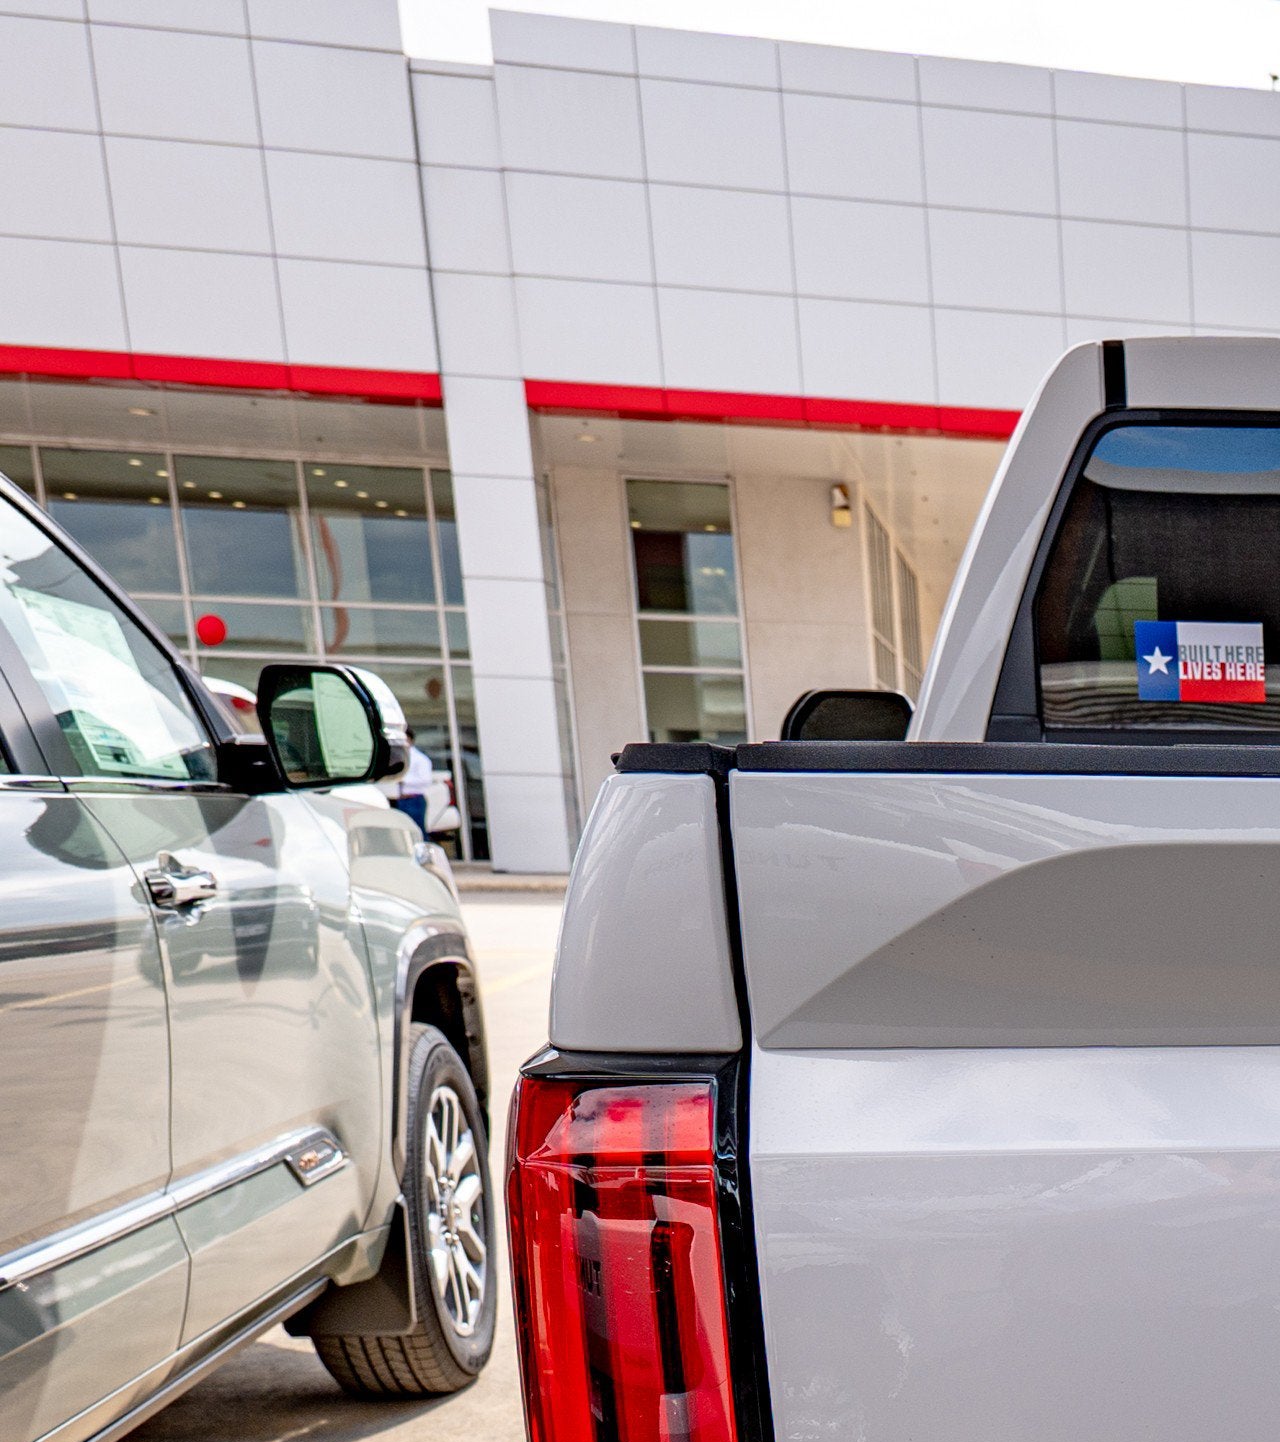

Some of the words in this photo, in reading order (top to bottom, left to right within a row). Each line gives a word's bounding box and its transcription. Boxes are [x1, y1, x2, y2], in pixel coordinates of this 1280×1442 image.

[1177, 644, 1221, 662] BUILT
[1225, 645, 1264, 663] HERE
[1179, 662, 1223, 680] LIVES
[1226, 662, 1265, 681] HERE
